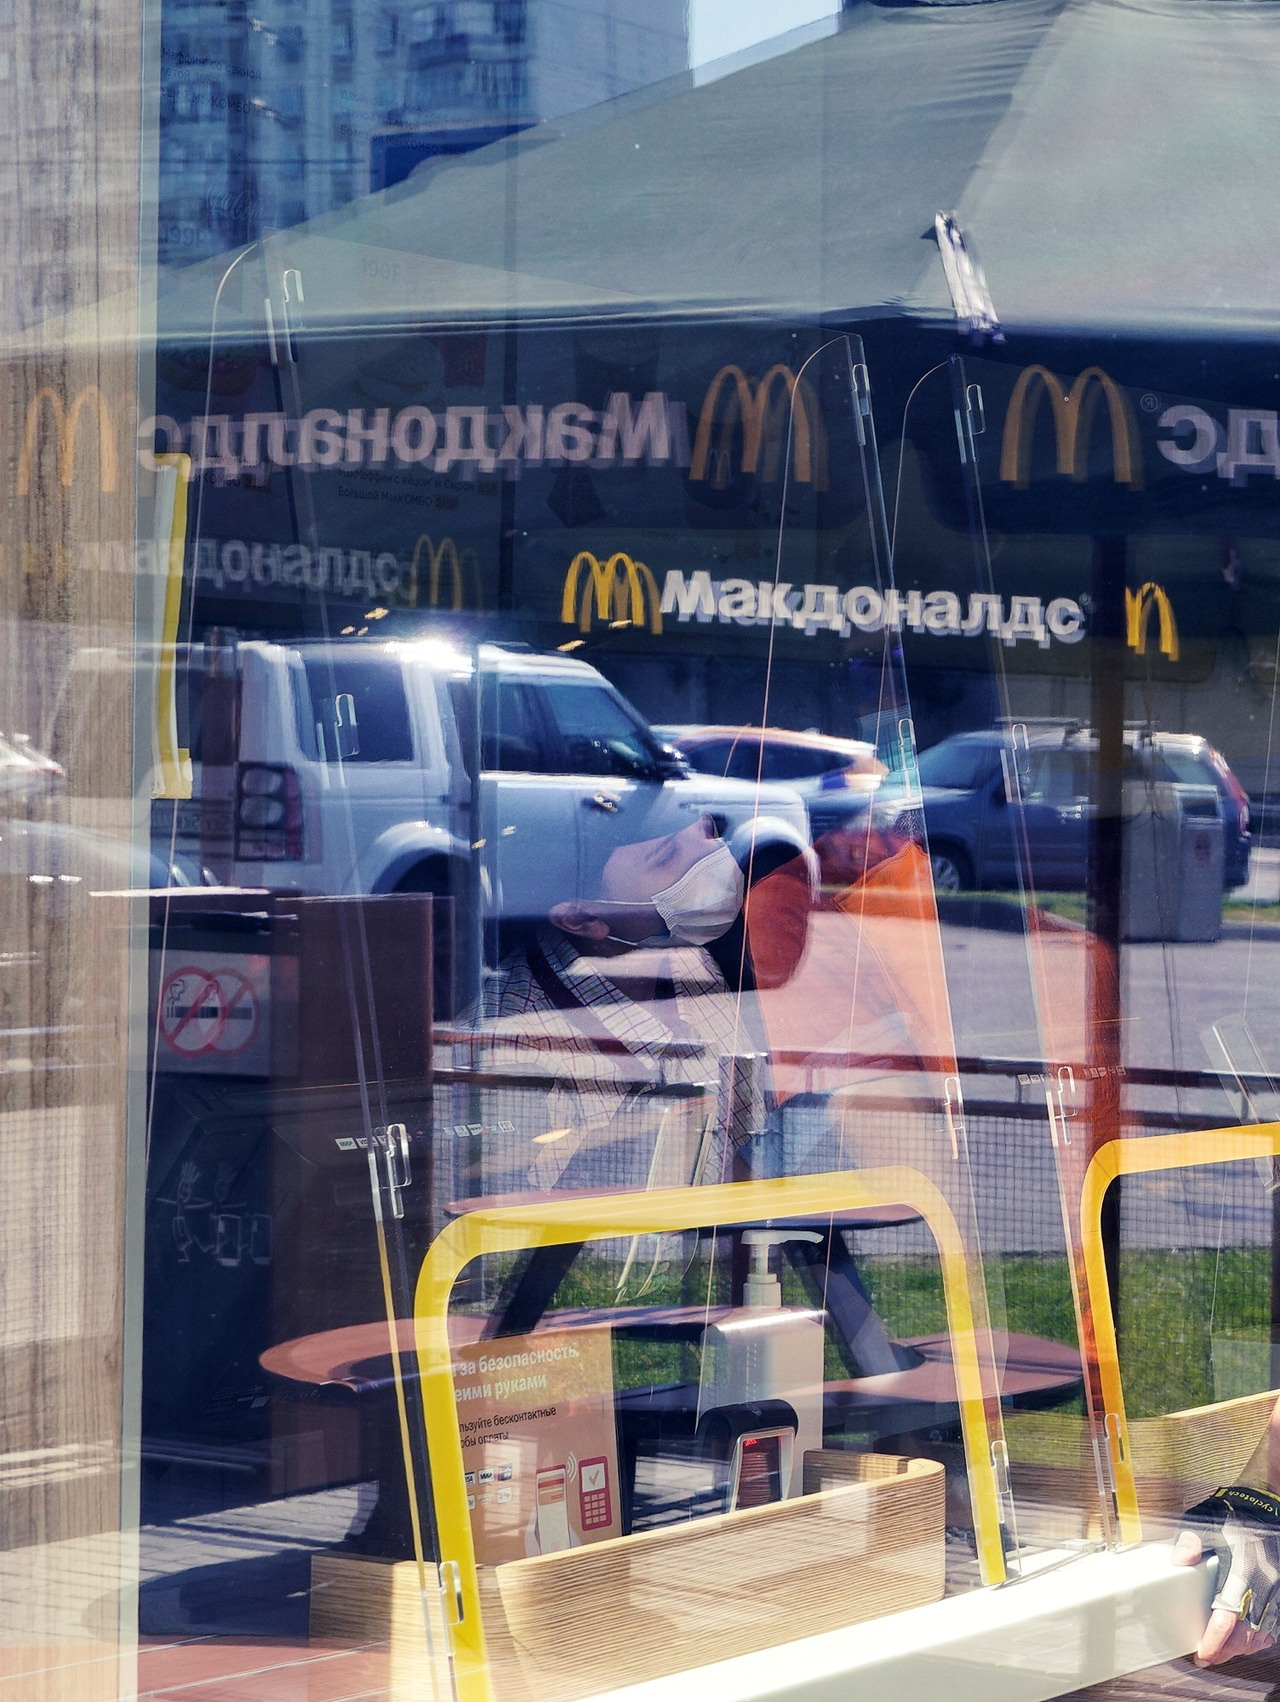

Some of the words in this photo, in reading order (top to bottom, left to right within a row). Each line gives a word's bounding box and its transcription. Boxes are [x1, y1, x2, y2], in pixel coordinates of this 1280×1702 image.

[660, 569, 1084, 646] Макдоналдс
[460, 1361, 476, 1377] за
[494, 1373, 547, 1400] руками
[493, 1406, 557, 1427] бесконтактные
[1227, 1489, 1275, 1513] cyclotech
